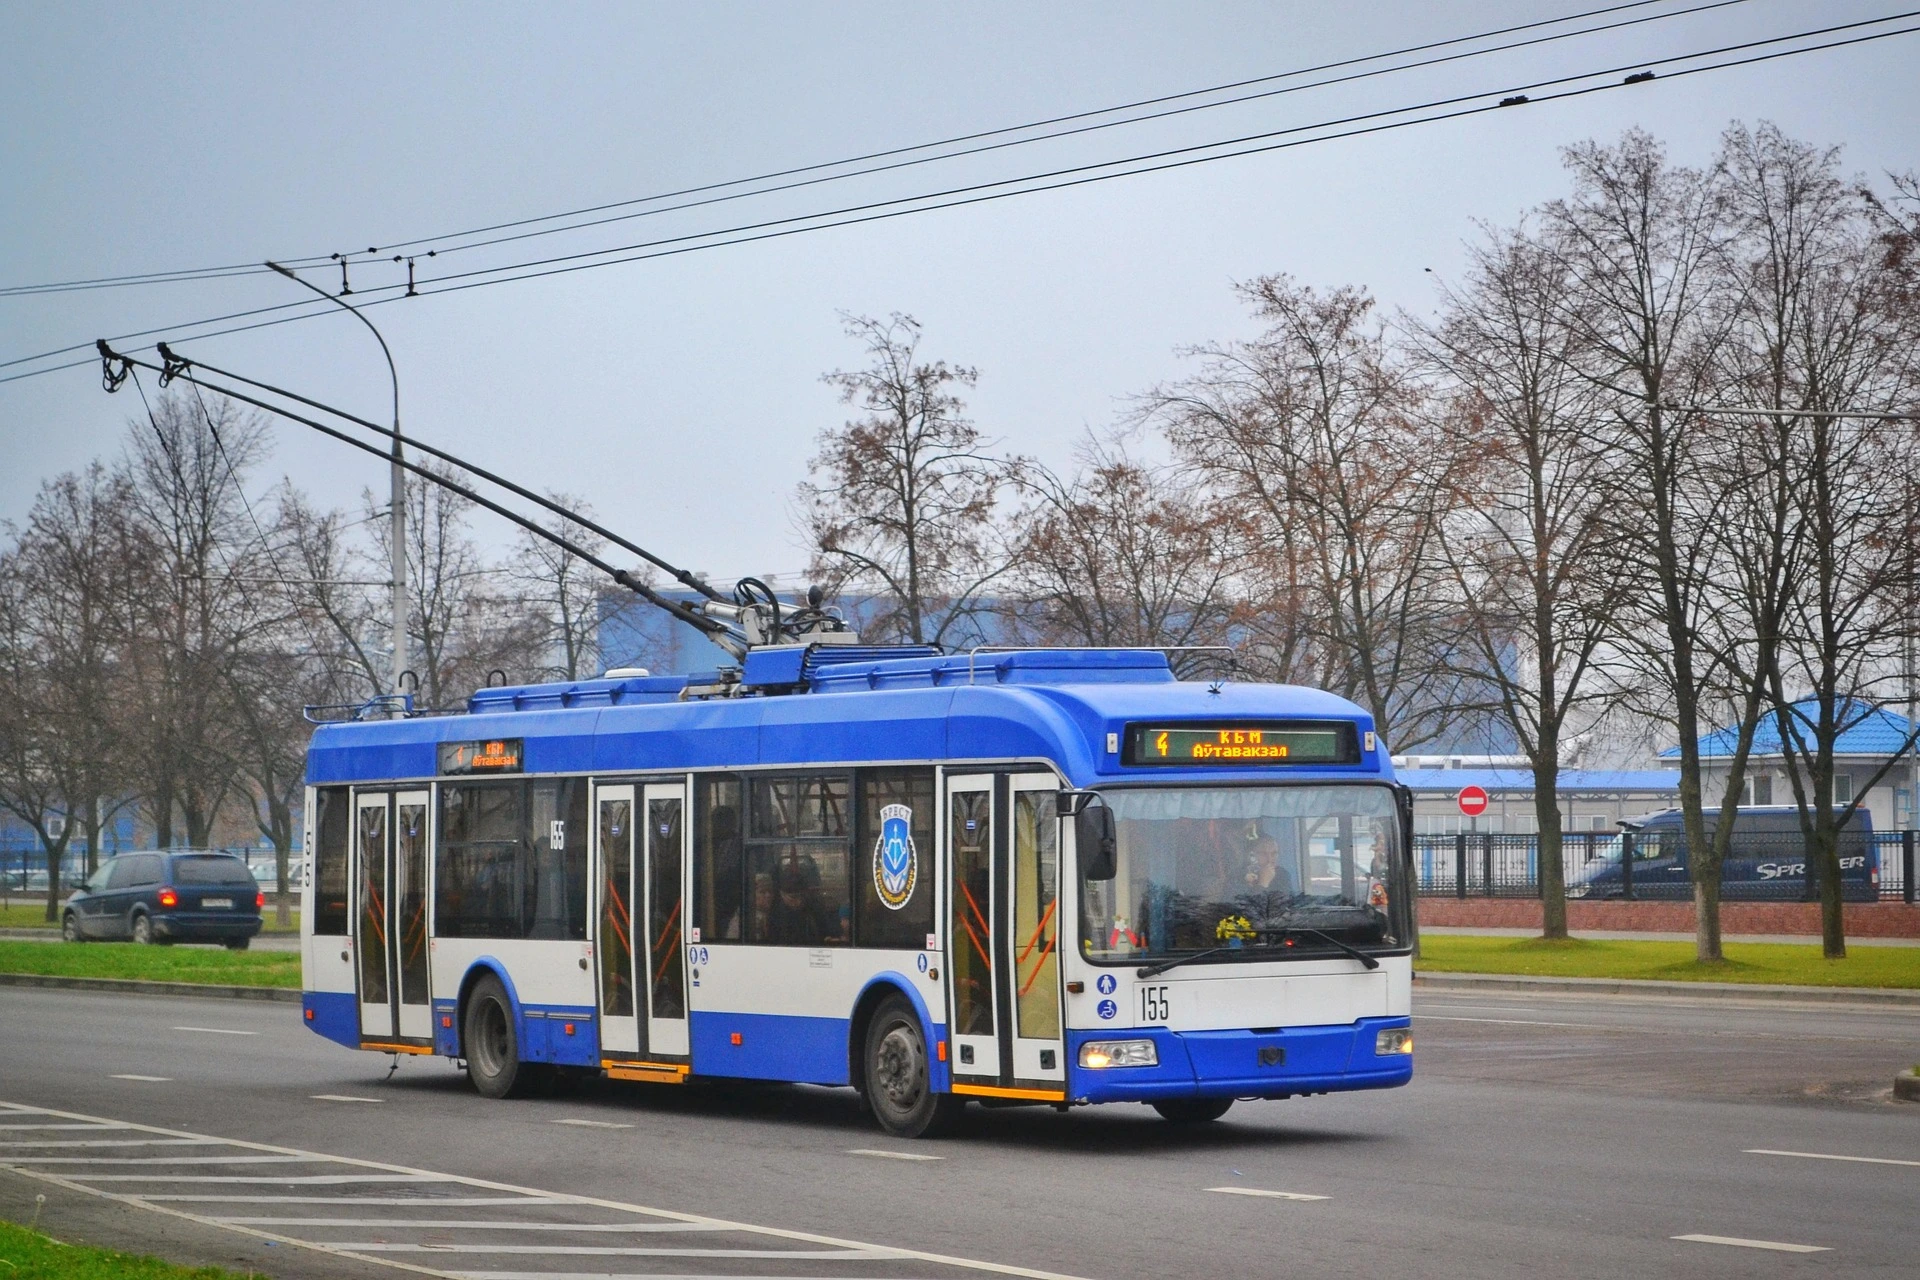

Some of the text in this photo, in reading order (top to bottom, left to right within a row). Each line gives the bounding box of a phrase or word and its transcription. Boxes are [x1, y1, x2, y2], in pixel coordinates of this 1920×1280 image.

[1156, 732, 1168, 756] 4
[1193, 743, 1288, 758] Аўтавакзал
[550, 820, 565, 850] 155
[1756, 856, 1866, 880] SPRER
[1141, 986, 1169, 1022] 155
